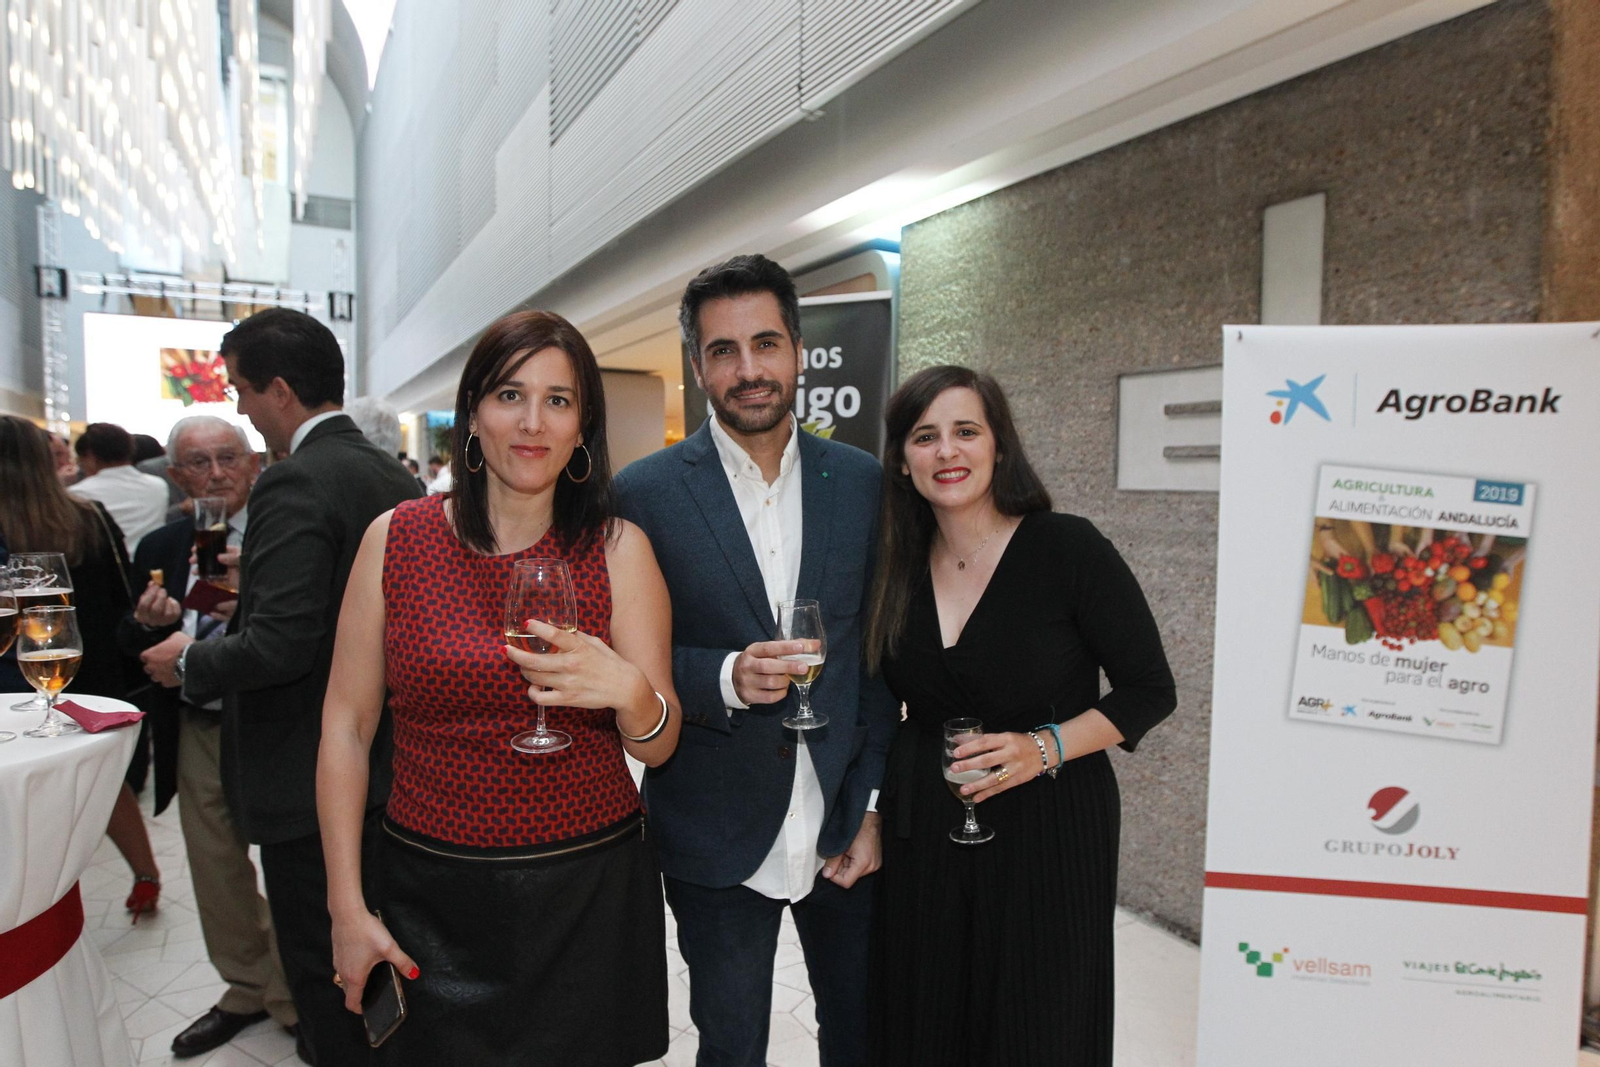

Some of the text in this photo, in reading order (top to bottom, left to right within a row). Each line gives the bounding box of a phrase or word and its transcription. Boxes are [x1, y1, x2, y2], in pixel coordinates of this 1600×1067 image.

[1376, 387, 1562, 420] AgroBank
[1332, 478, 1434, 498] AGRICULTURA
[1479, 485, 1519, 502] 2019
[1328, 499, 1519, 529] ALIMENTACIÓN ANDALUCÍA
[1311, 644, 1449, 675] Manos de mujer
[1384, 670, 1490, 694] para el agro
[1293, 957, 1372, 978] vellsam
[1403, 960, 1450, 973] VIAJES
